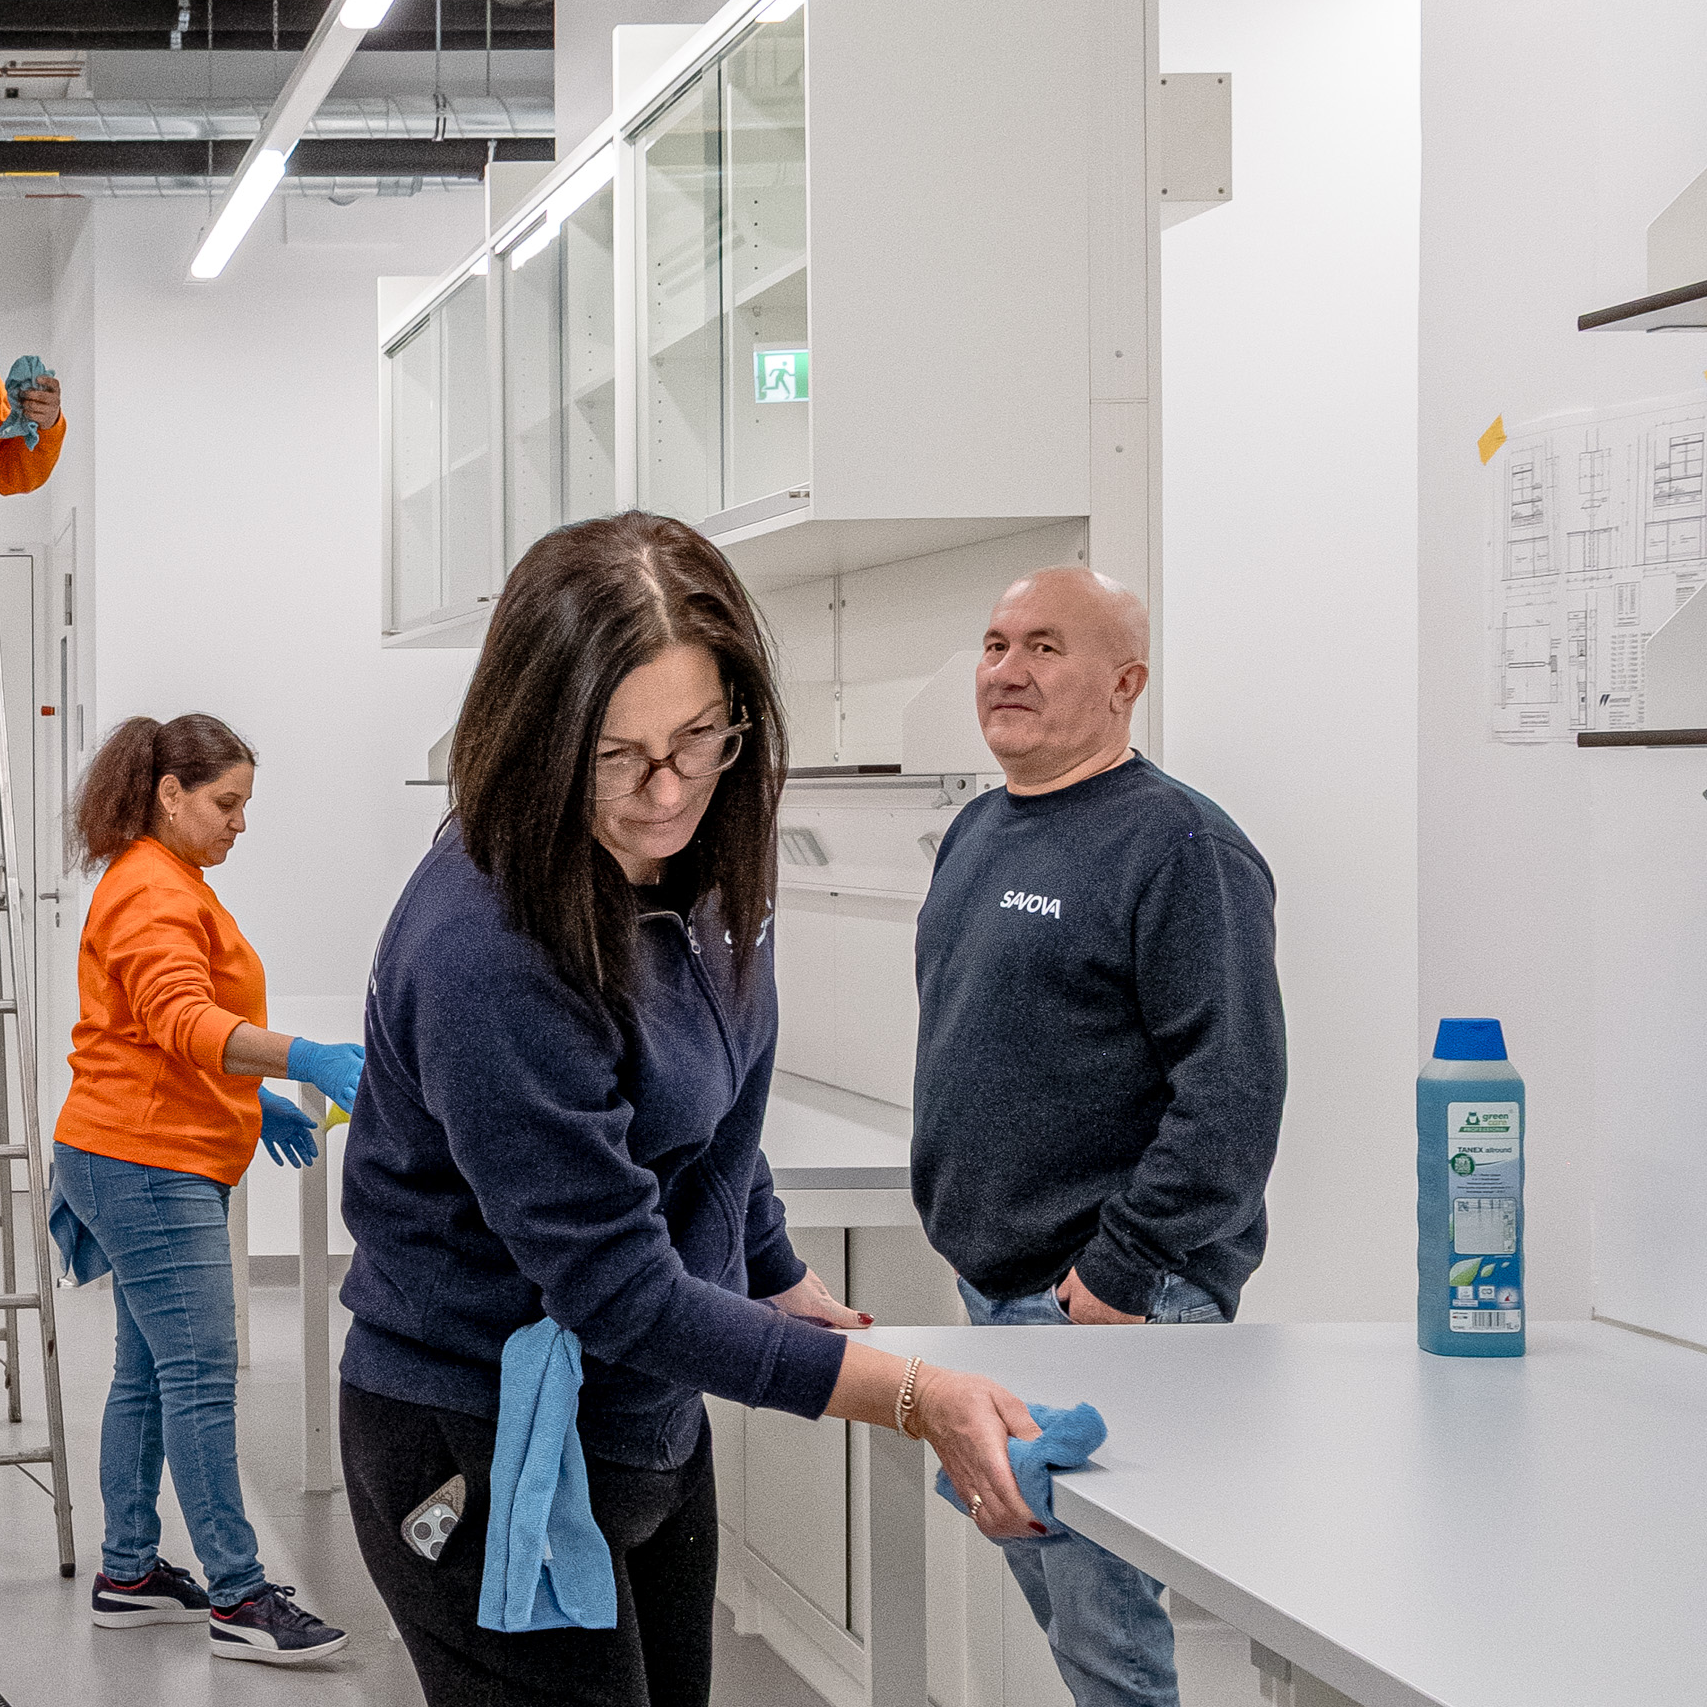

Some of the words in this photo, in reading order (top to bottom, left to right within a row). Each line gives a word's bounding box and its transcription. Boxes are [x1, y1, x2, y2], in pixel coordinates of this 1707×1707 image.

[999, 889, 1062, 920] SAVOVA
[1482, 1113, 1509, 1122] green
[1457, 1146, 1484, 1154] TANEX
[1485, 1146, 1512, 1154] allround
